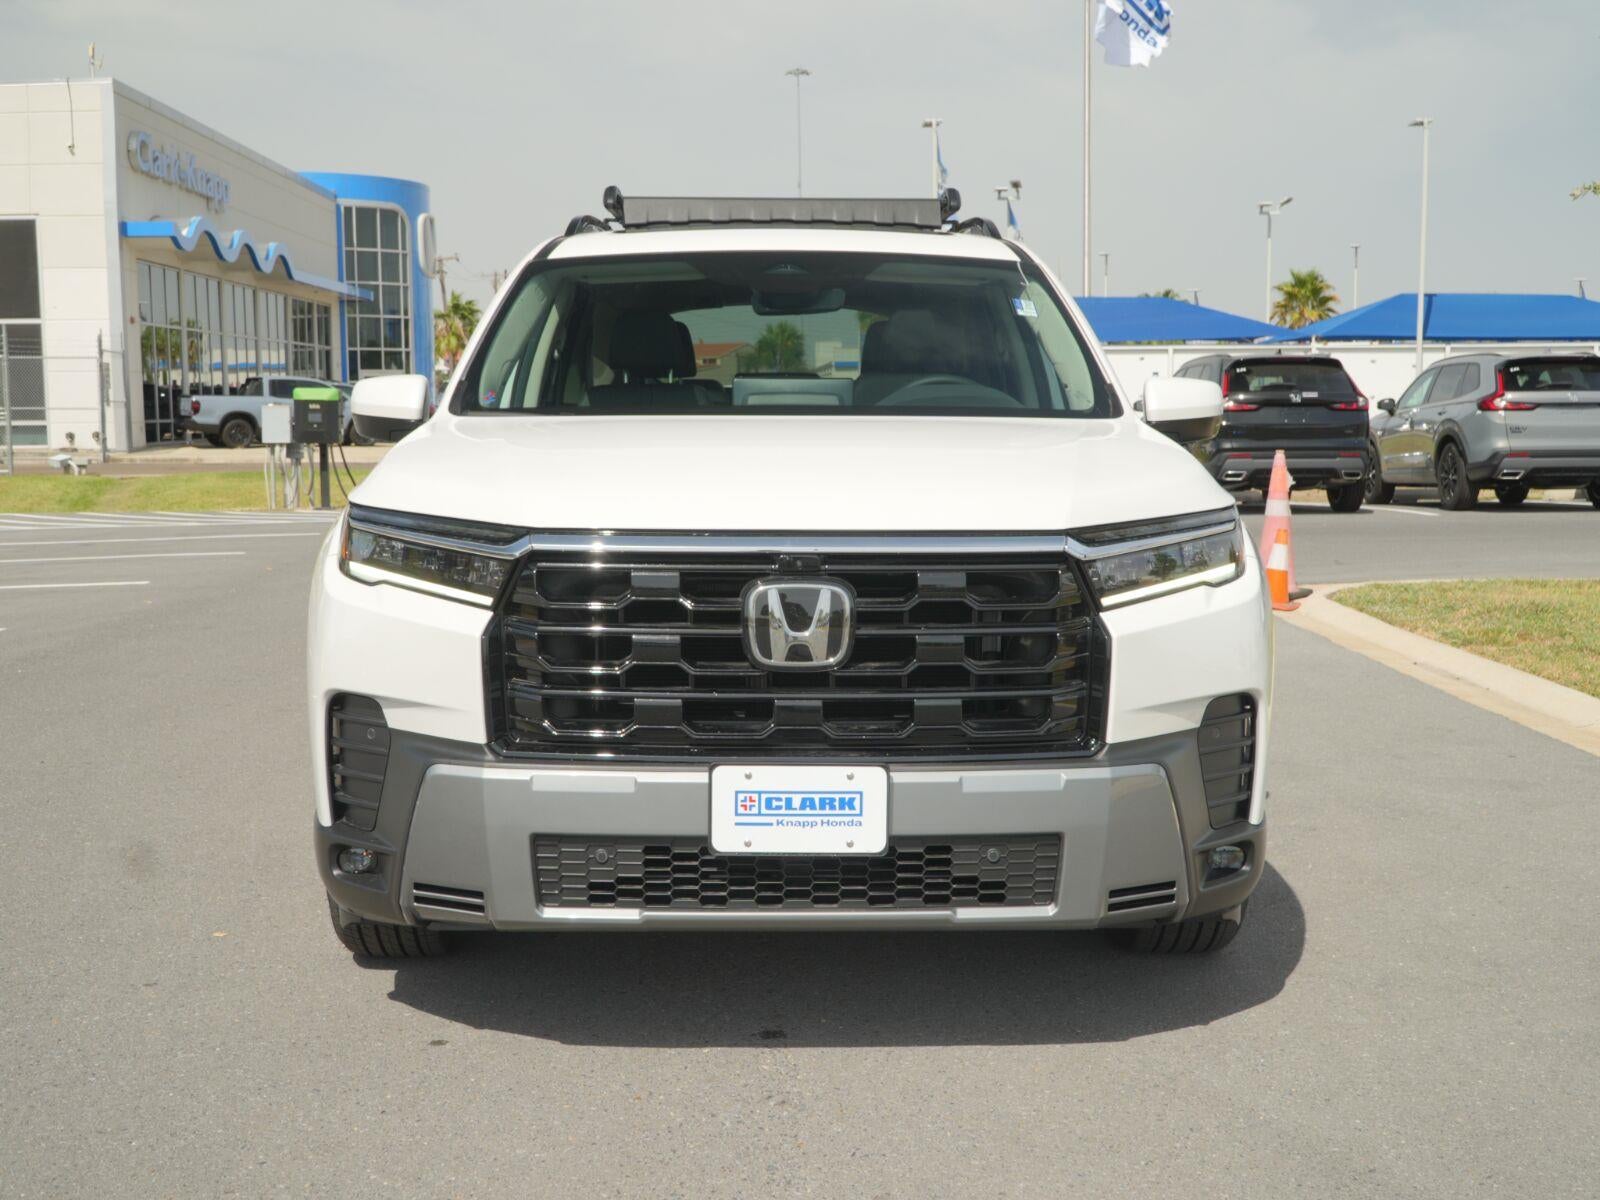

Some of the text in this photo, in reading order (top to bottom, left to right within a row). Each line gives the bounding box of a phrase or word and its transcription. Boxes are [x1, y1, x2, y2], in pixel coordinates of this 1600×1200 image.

[1119, 10, 1158, 48] onda
[764, 796, 857, 811] CLARK
[776, 819, 863, 829] Knapp Honda
